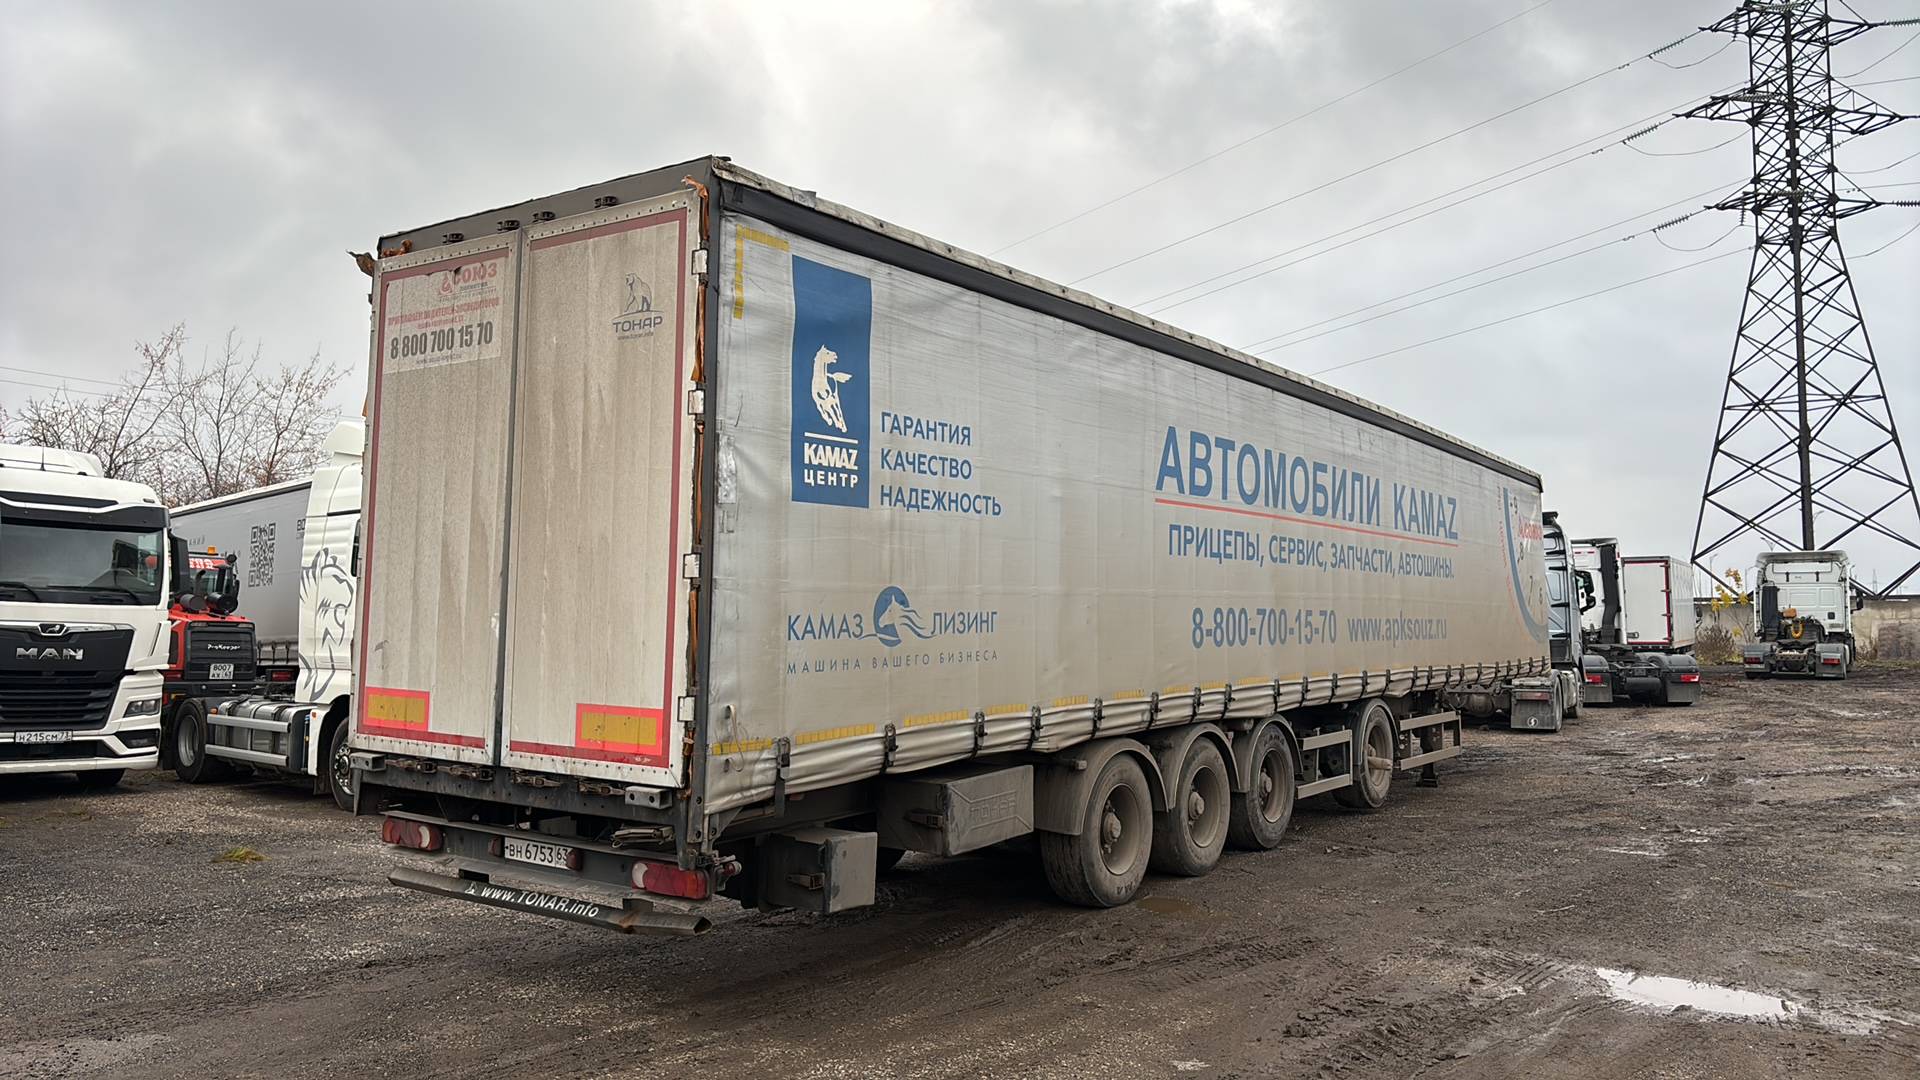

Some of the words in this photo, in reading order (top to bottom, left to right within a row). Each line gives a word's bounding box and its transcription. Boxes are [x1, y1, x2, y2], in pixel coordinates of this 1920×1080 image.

[390, 337, 399, 359] 8
[402, 332, 428, 357] 800
[431, 327, 455, 352] 700
[458, 324, 474, 348] 15
[477, 320, 493, 345] 70
[612, 316, 663, 333] ТОНАР
[881, 411, 971, 446] ГАРАНТИЯ
[804, 442, 859, 470] KAMAZ
[881, 448, 972, 479] КАЧЕСТВО
[804, 469, 859, 487] ЦЕНТР
[1156, 426, 1380, 527] АВТОМОБИЛИ
[1393, 482, 1459, 540] KAMAZ
[880, 484, 1002, 516] НАДЕЖНОСТЬ
[1169, 524, 1265, 568] ПРИЦЕПЫ,
[1269, 534, 1327, 572] СЕРВИС,
[1330, 542, 1396, 578] ЗАПЧАСТИ,
[1398, 551, 1455, 579] АВТОШИНЫ.
[787, 613, 864, 641] КАМАЗ
[931, 611, 998, 635] ЛИЗИНГ
[1191, 607, 1337, 649] 8-800-700-15-70
[1347, 608, 1448, 648] www.apksouz.ru
[16, 647, 84, 660] MAN
[786, 658, 861, 675] МАШИНА
[872, 653, 930, 669] ВАШЕГО
[939, 649, 998, 665] БИЗНЕСА
[509, 844, 523, 858] ВН
[525, 843, 554, 863] 6753
[481, 887, 599, 917] www.TONAR.info
